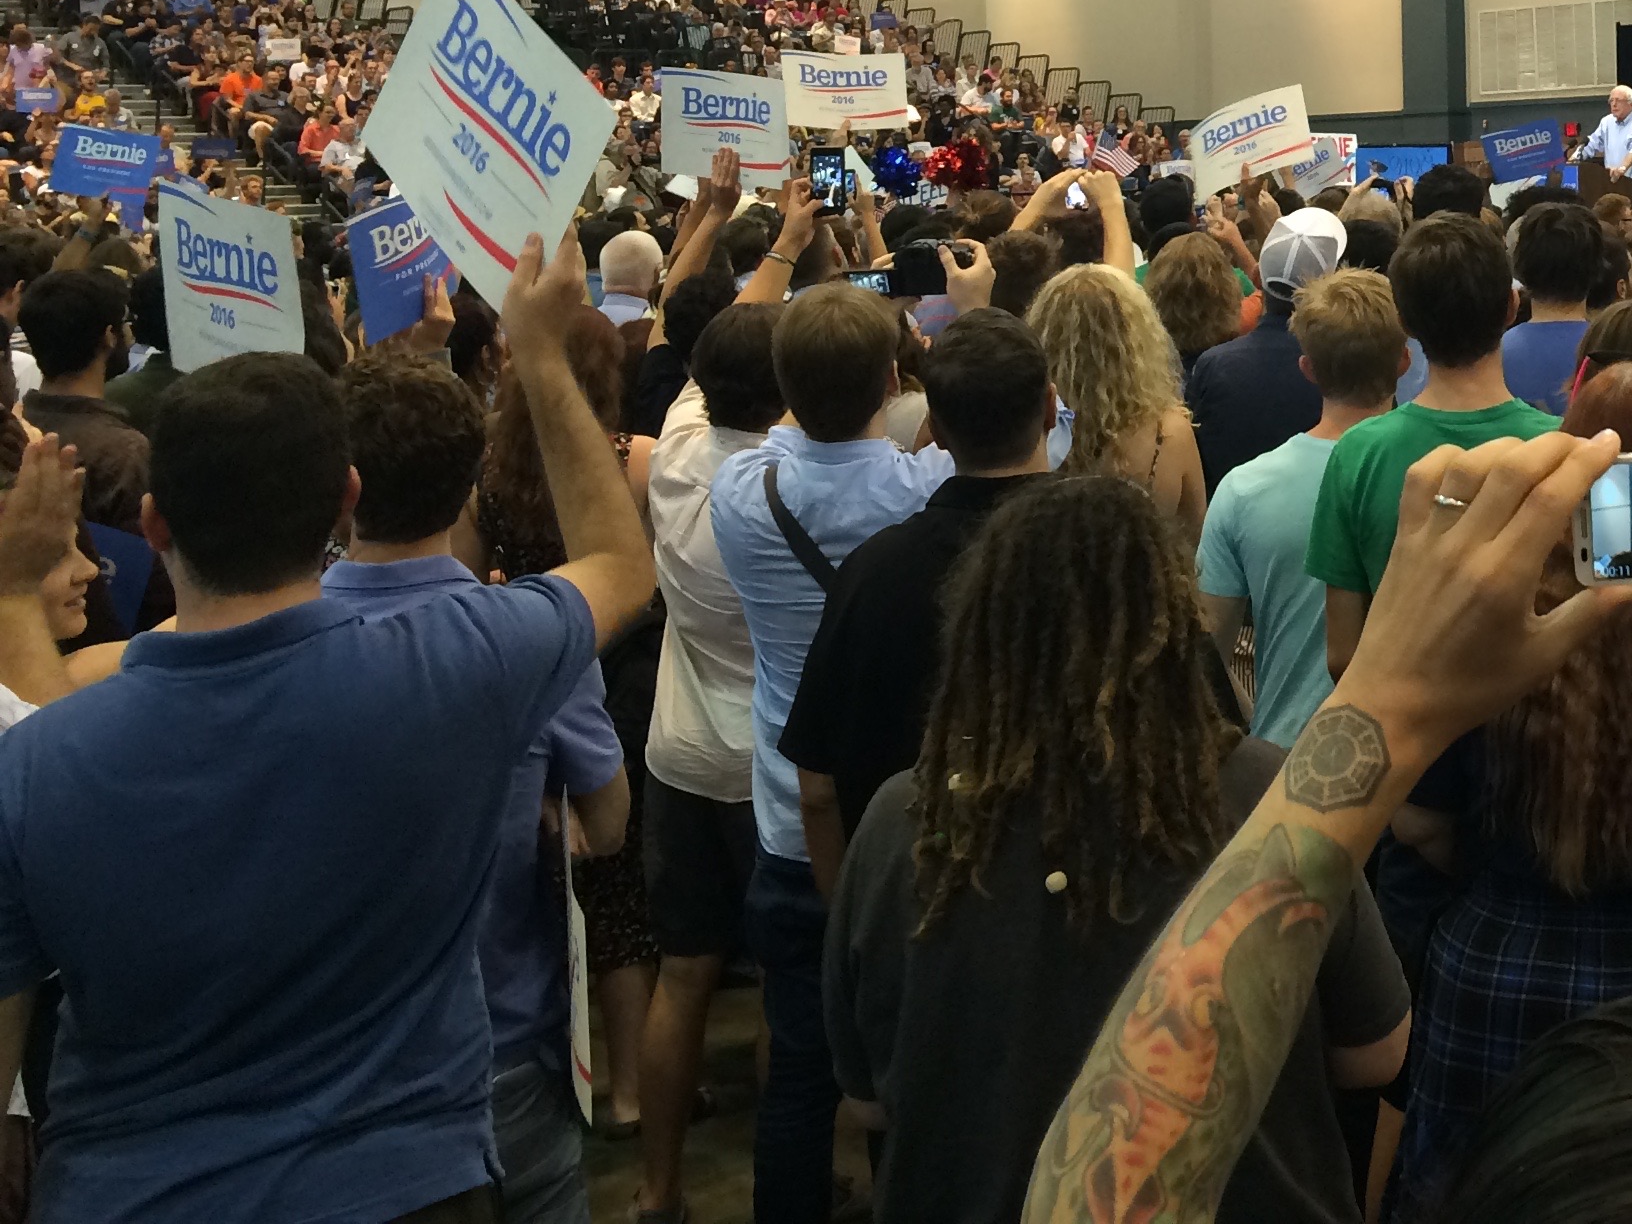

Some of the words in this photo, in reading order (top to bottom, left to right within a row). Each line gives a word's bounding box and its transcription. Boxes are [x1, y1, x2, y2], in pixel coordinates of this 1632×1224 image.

[798, 63, 888, 88] Bernie
[681, 86, 771, 125] Bernie
[831, 95, 855, 105] 2016
[718, 131, 741, 145] 2016
[1201, 104, 1288, 155] Bernie
[1493, 127, 1552, 156] Bernie
[73, 135, 147, 165] Bernie
[452, 123, 490, 174] 2016
[1233, 140, 1257, 156] 2016
[1292, 149, 1331, 176] ernie
[369, 216, 428, 264] Ber
[175, 217, 279, 297] Bernie
[210, 303, 236, 329] 2016
